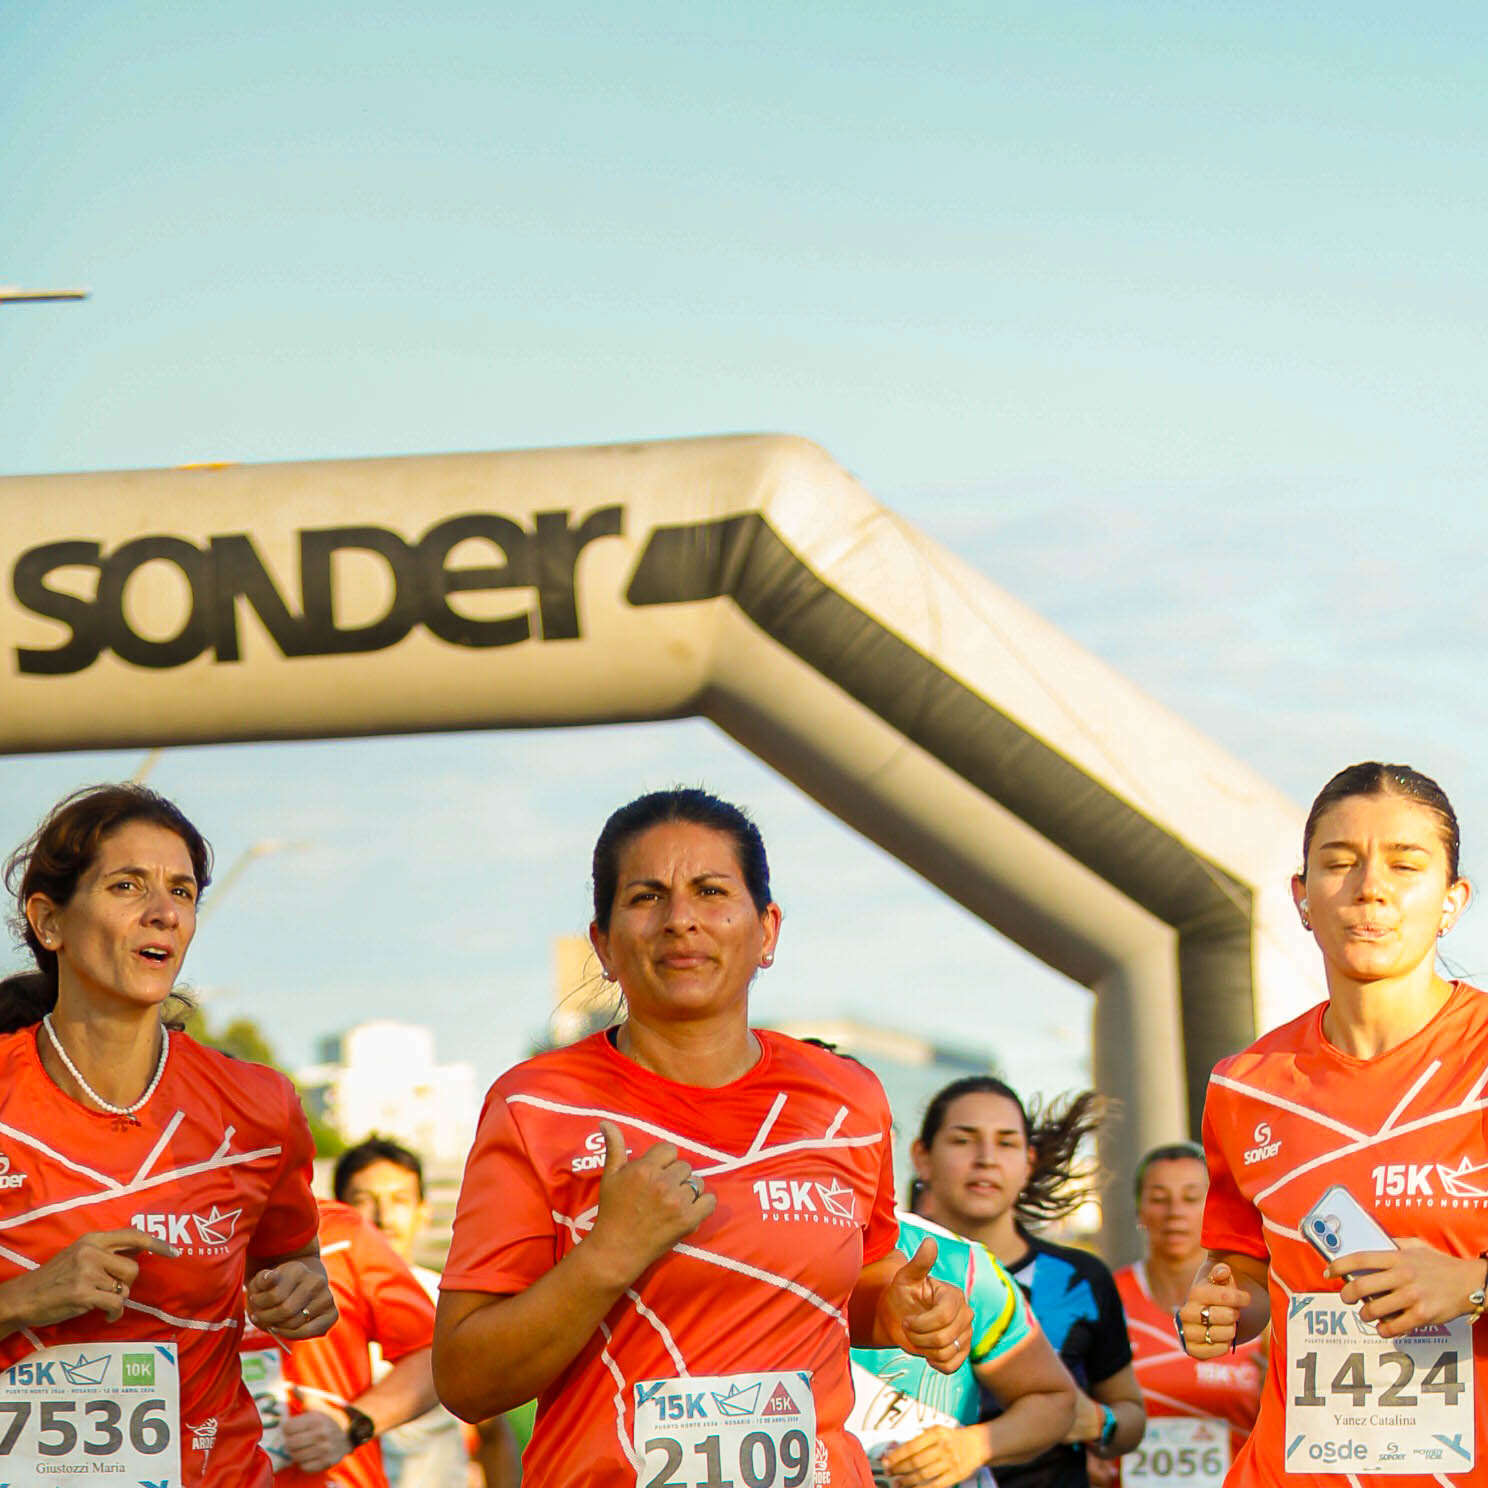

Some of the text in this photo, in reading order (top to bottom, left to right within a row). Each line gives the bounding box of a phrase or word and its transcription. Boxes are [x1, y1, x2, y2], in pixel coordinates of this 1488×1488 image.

[1371, 1164, 1434, 1196] 15K
[752, 1180, 817, 1211] 15K
[1375, 1199, 1488, 1209] PUERTO NORTE
[130, 1213, 193, 1244] 15K
[762, 1213, 819, 1223] PUERTO
[1304, 1310, 1348, 1336] 15K
[5, 1360, 57, 1386] 15K
[125, 1362, 152, 1377] 10K
[1294, 1351, 1466, 1407] 1424
[654, 1391, 708, 1421] 15K
[770, 1396, 792, 1411] 15K
[0, 1399, 170, 1457] 7536
[1369, 1414, 1416, 1426] Catalina
[1130, 1447, 1222, 1476] 2056
[1308, 1439, 1368, 1461] osde
[35, 1461, 126, 1474] Giustozzi Maria
